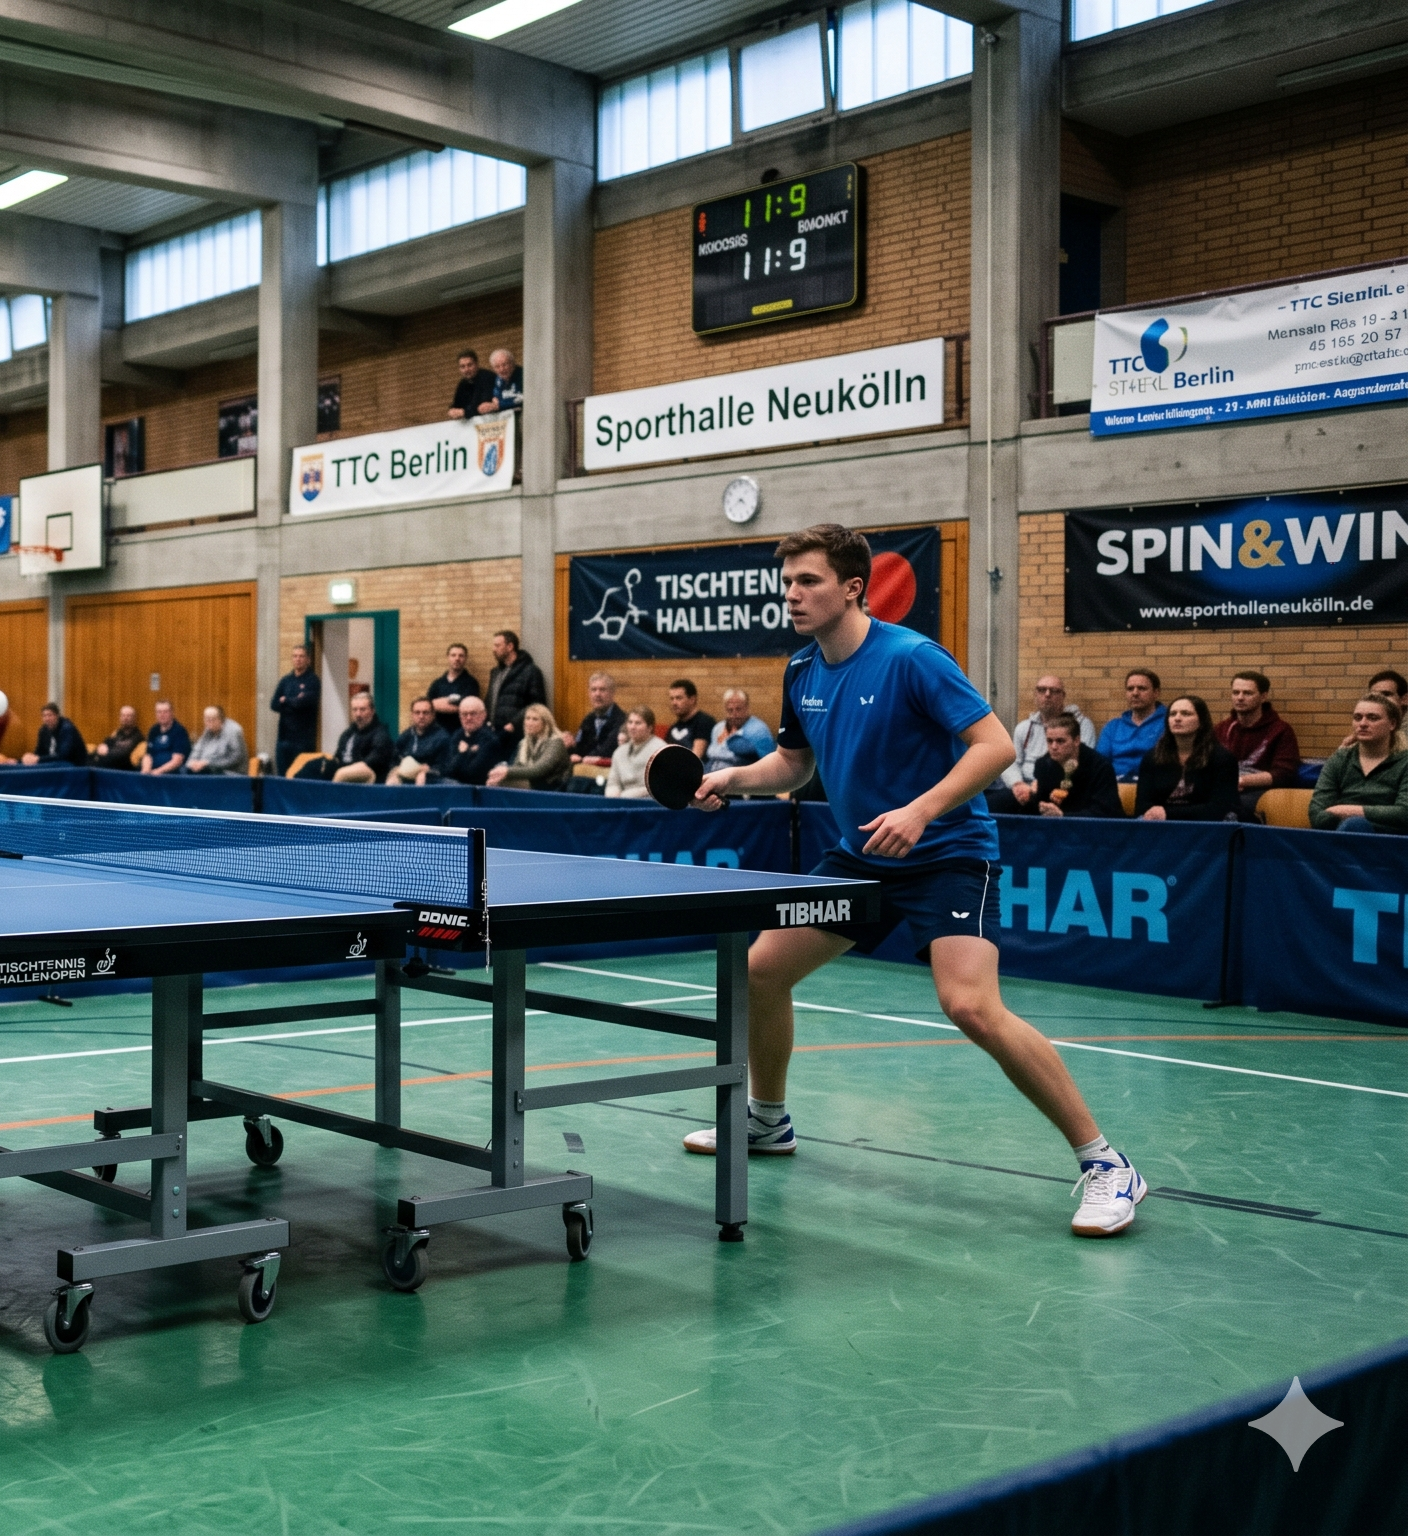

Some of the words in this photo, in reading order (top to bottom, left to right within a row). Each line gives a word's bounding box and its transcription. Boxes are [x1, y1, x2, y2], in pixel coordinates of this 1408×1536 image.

[744, 183, 806, 228] 11:9
[744, 237, 807, 281] 11:9
[1290, 295, 1323, 312] TTC
[1362, 313, 1377, 326] 19
[1309, 339, 1326, 352] 45
[1361, 331, 1379, 345] 20
[1384, 327, 1402, 341] 57
[1109, 356, 1144, 374] TTC
[1174, 366, 1234, 389] Berlin
[595, 395, 754, 452] Sporthalle
[767, 369, 926, 422] Neukölln
[331, 452, 380, 488] TTC
[390, 440, 468, 480] Berlin
[776, 898, 851, 927] TIBHAR
